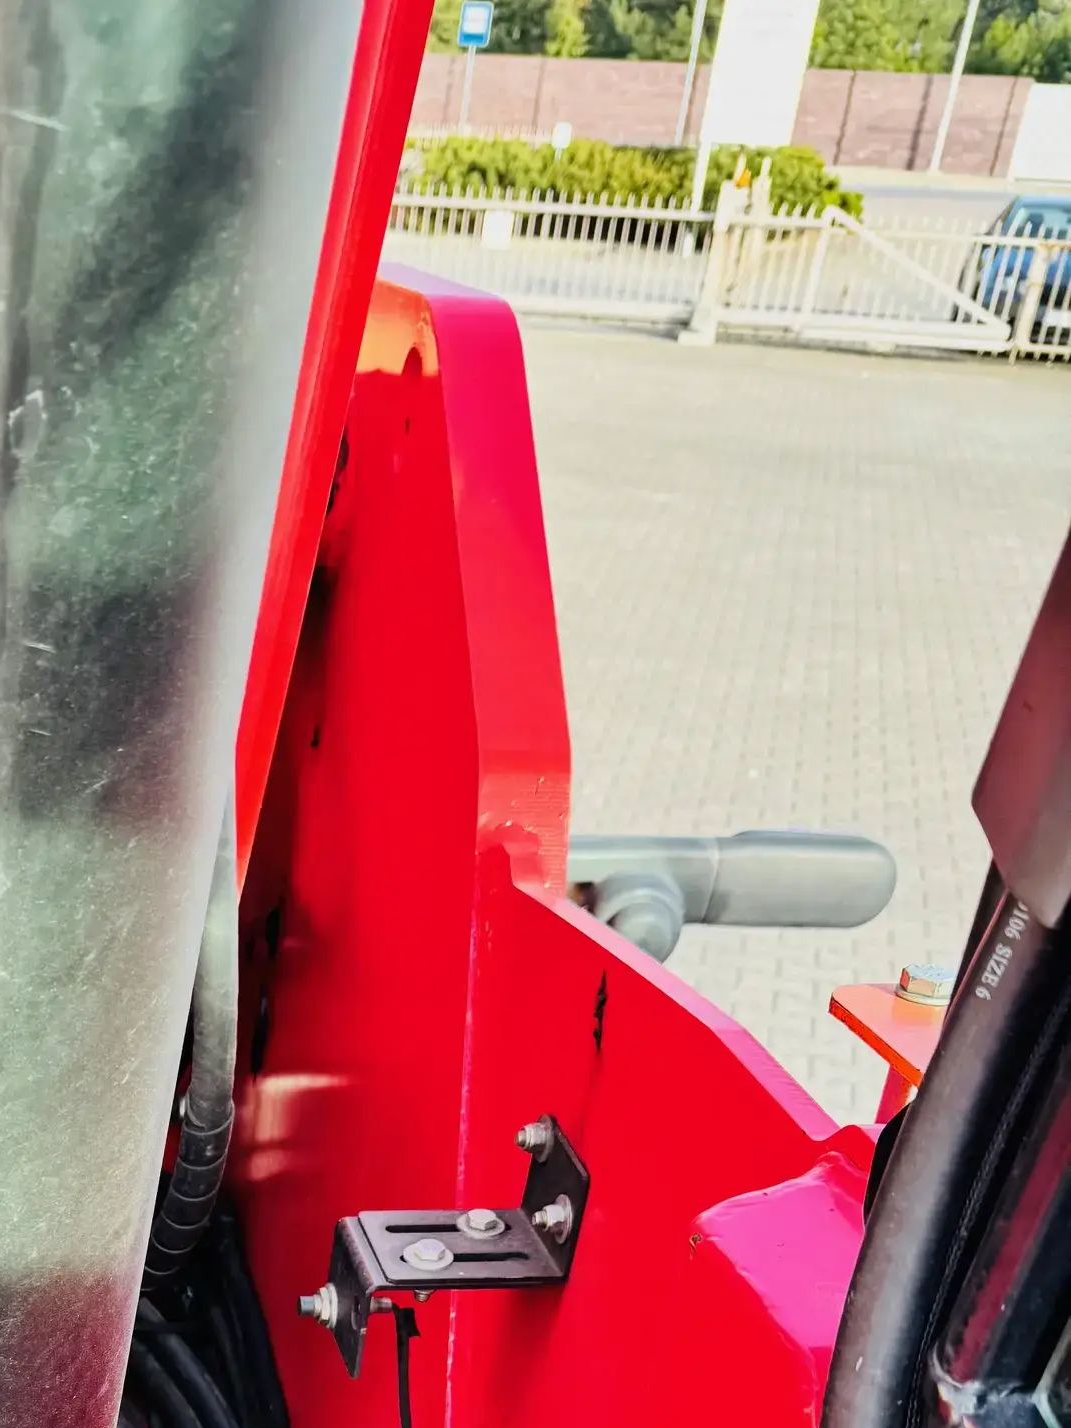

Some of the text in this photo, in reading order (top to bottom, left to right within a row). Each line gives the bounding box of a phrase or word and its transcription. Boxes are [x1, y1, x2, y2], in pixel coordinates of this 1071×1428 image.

[975, 900, 1030, 1001] 106 SIZE 6
